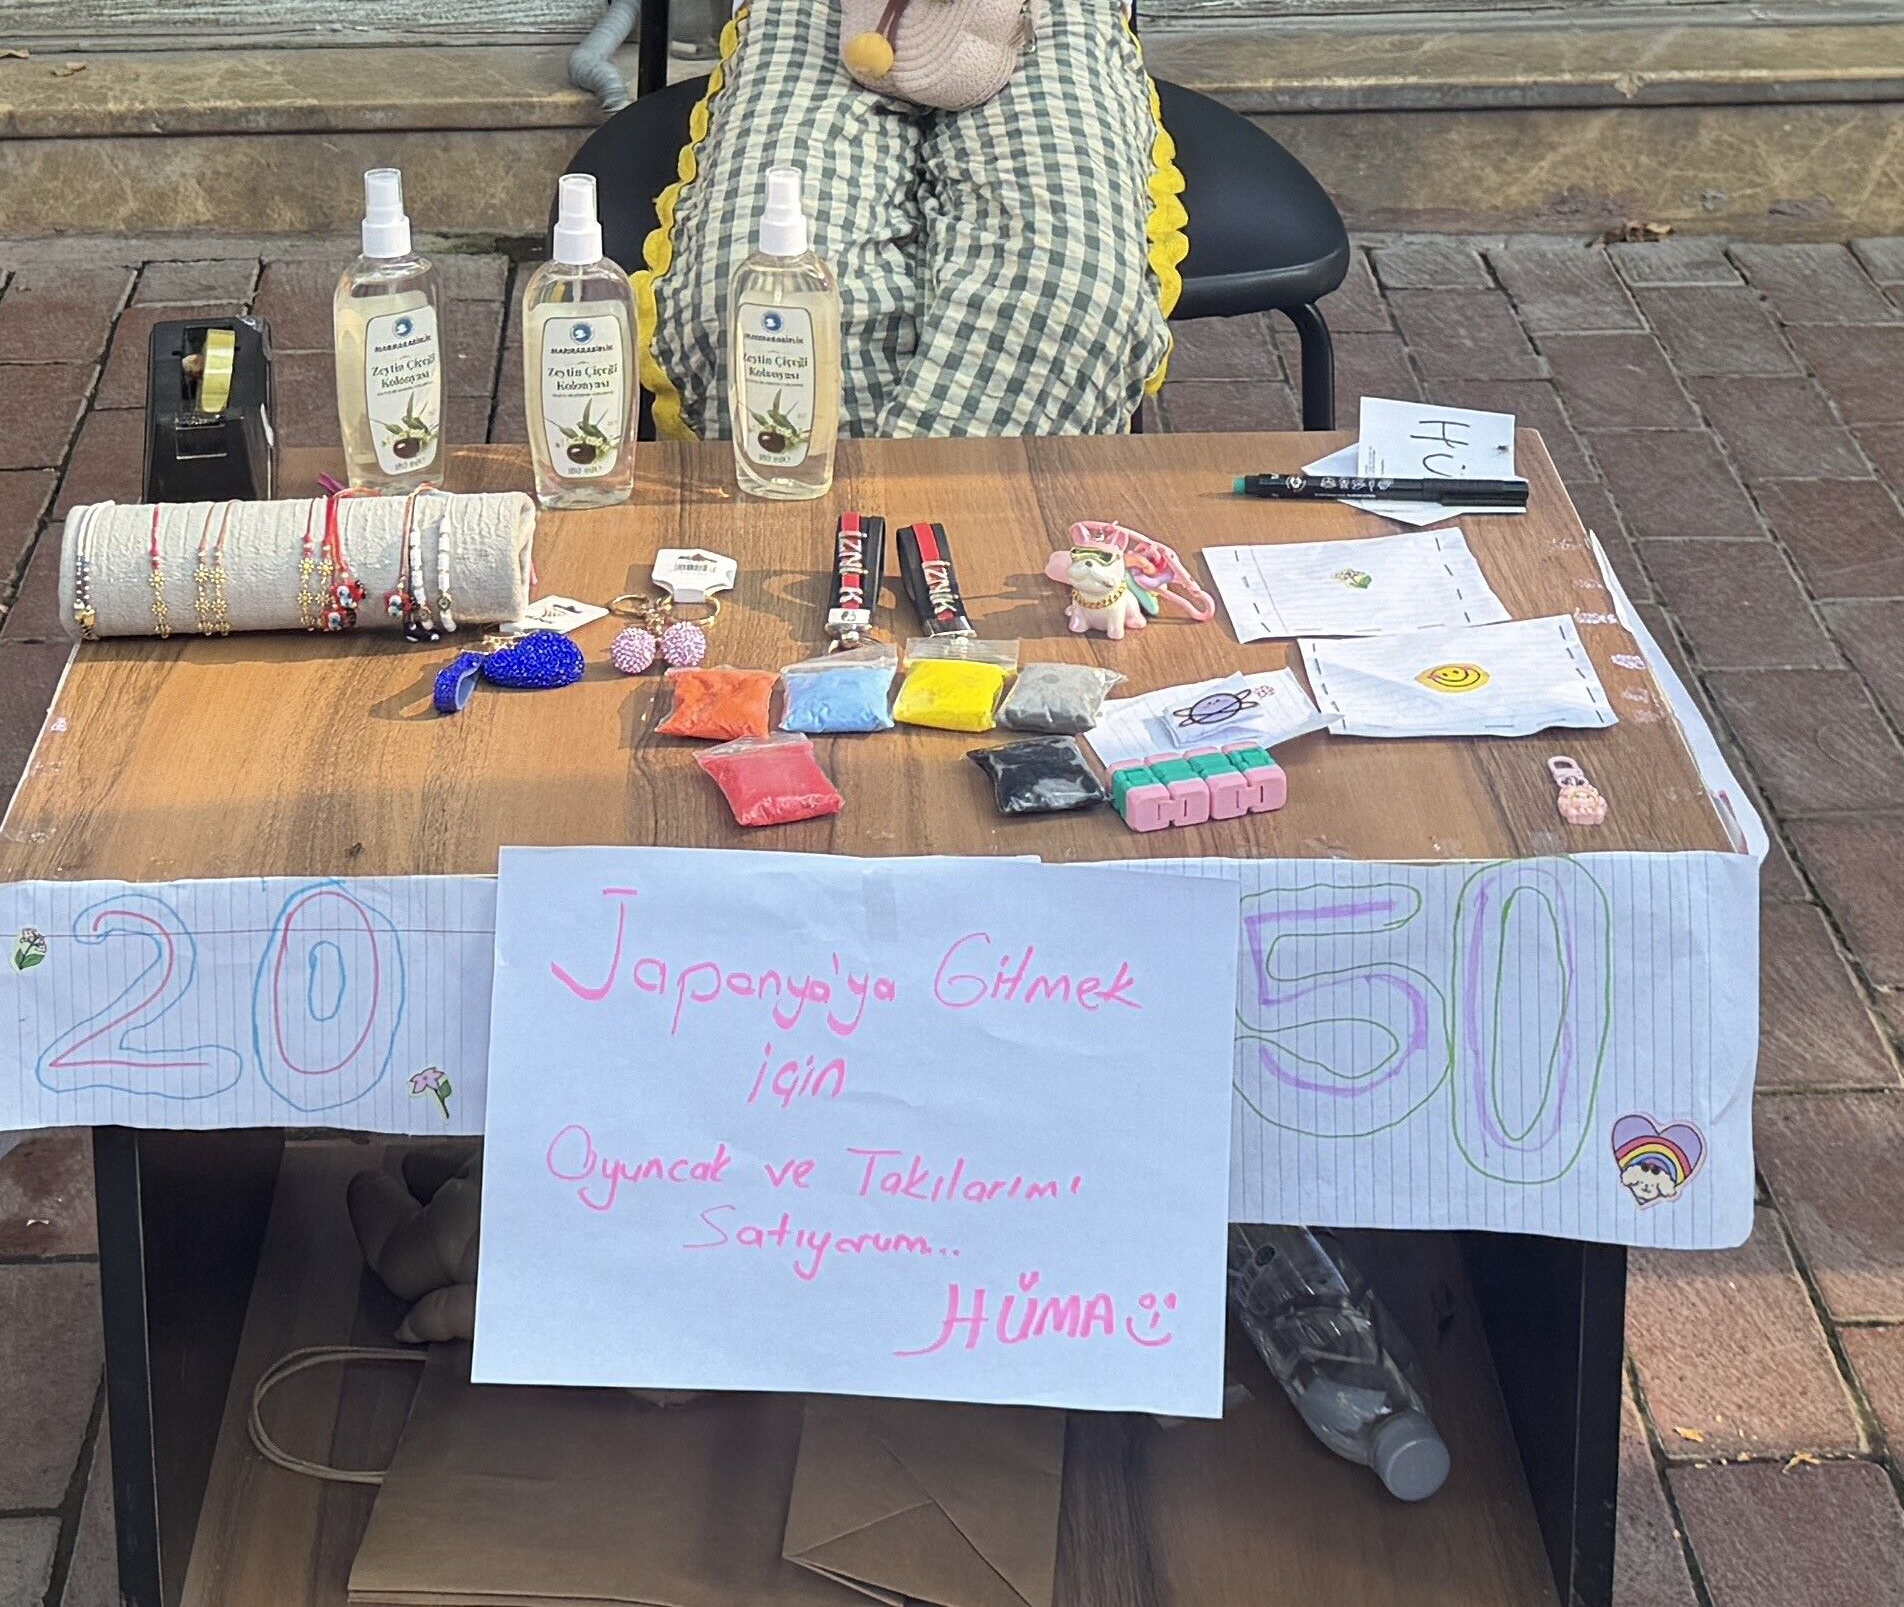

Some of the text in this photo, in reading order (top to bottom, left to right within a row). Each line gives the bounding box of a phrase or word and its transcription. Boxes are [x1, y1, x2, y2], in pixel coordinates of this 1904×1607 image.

[371, 361, 405, 378] Zeytin
[547, 362, 619, 379] Zeytin Çiçeği
[838, 530, 869, 605] İZNİK
[921, 559, 960, 615] İZNİK
[35, 878, 407, 1113] 20
[933, 931, 1144, 1011] Gitmek
[1233, 855, 1612, 1185] 50
[545, 1124, 1084, 1211] Oyuncak ve Takılarımı
[893, 1270, 1117, 1358] HÜMA
